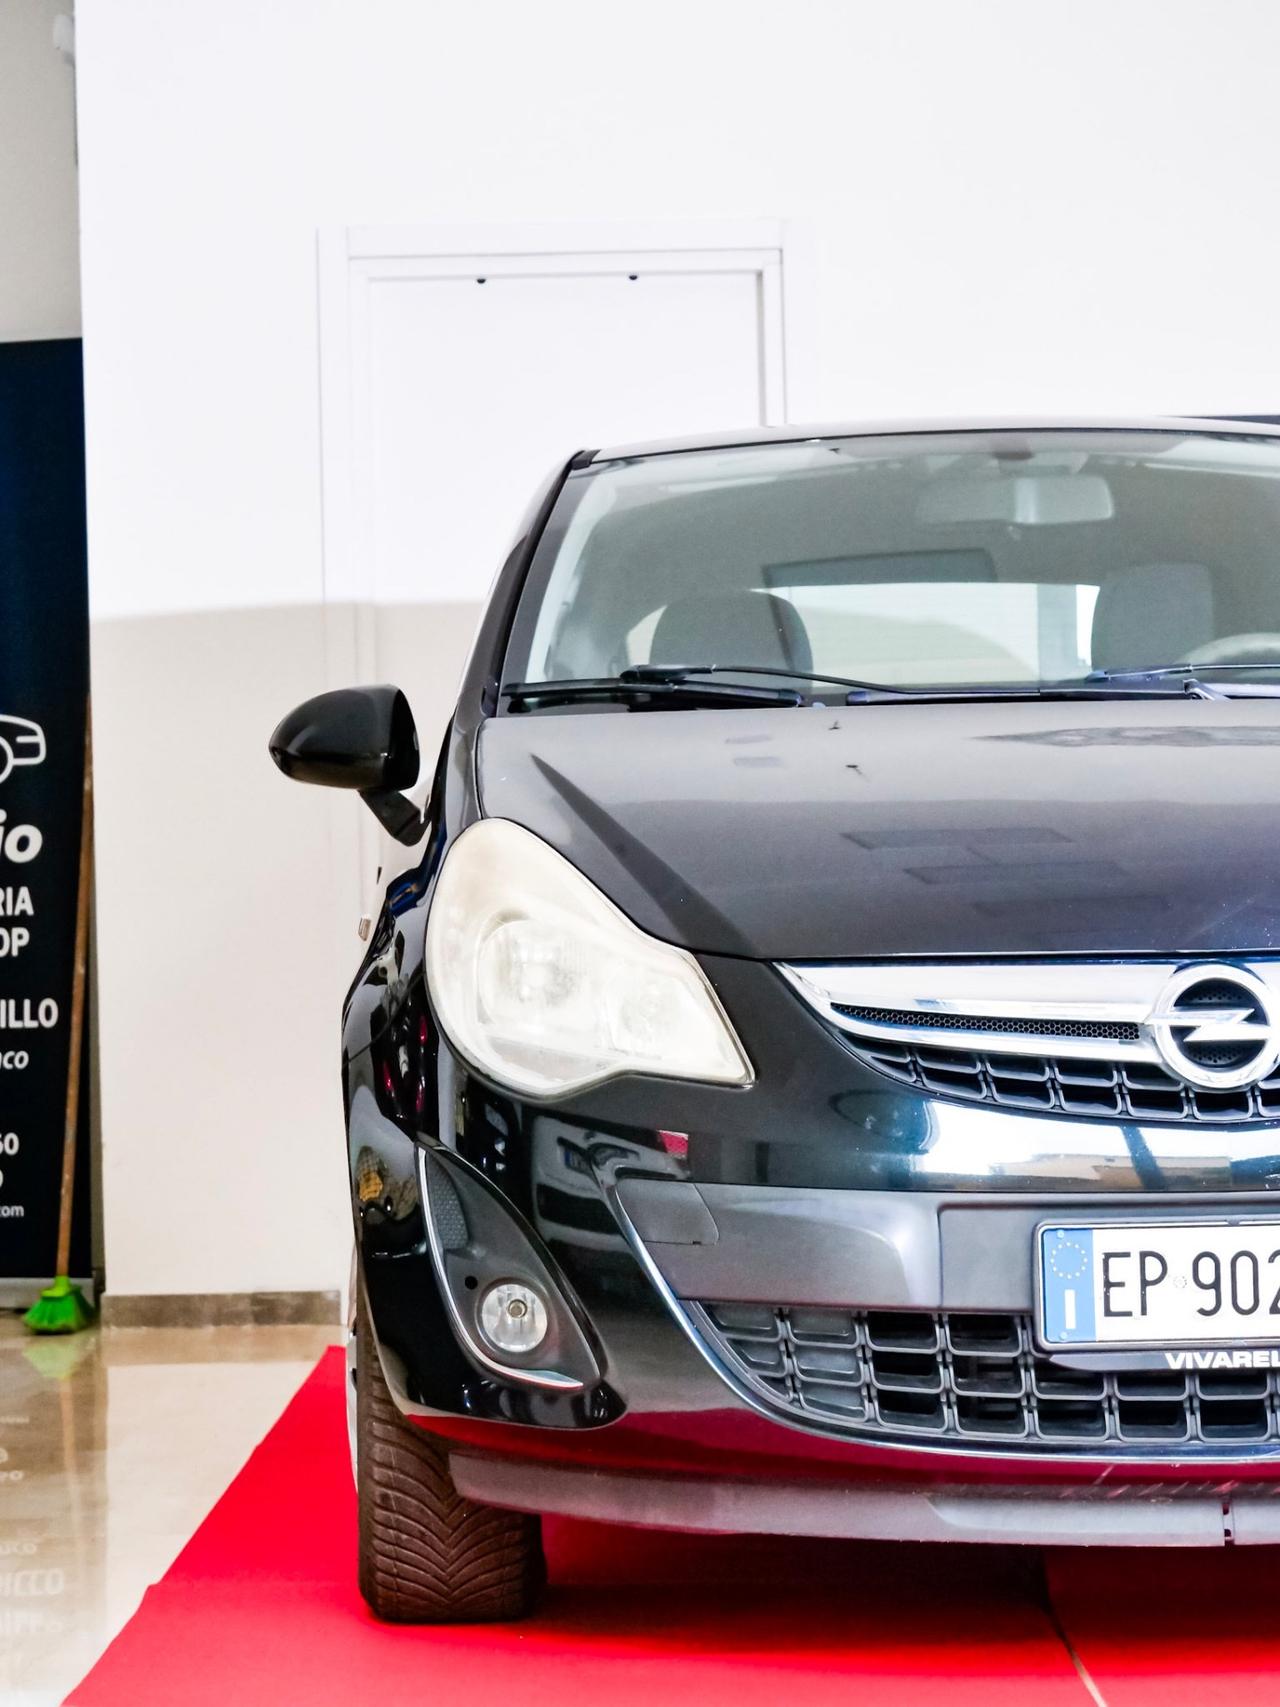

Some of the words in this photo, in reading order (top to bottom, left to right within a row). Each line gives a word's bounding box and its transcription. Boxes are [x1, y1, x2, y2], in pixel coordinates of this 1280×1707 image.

[0, 887, 34, 916] IA
[0, 1051, 28, 1069] co
[0, 1133, 19, 1155] 0
[0, 1206, 24, 1217] om
[1103, 1251, 1167, 1316] EP
